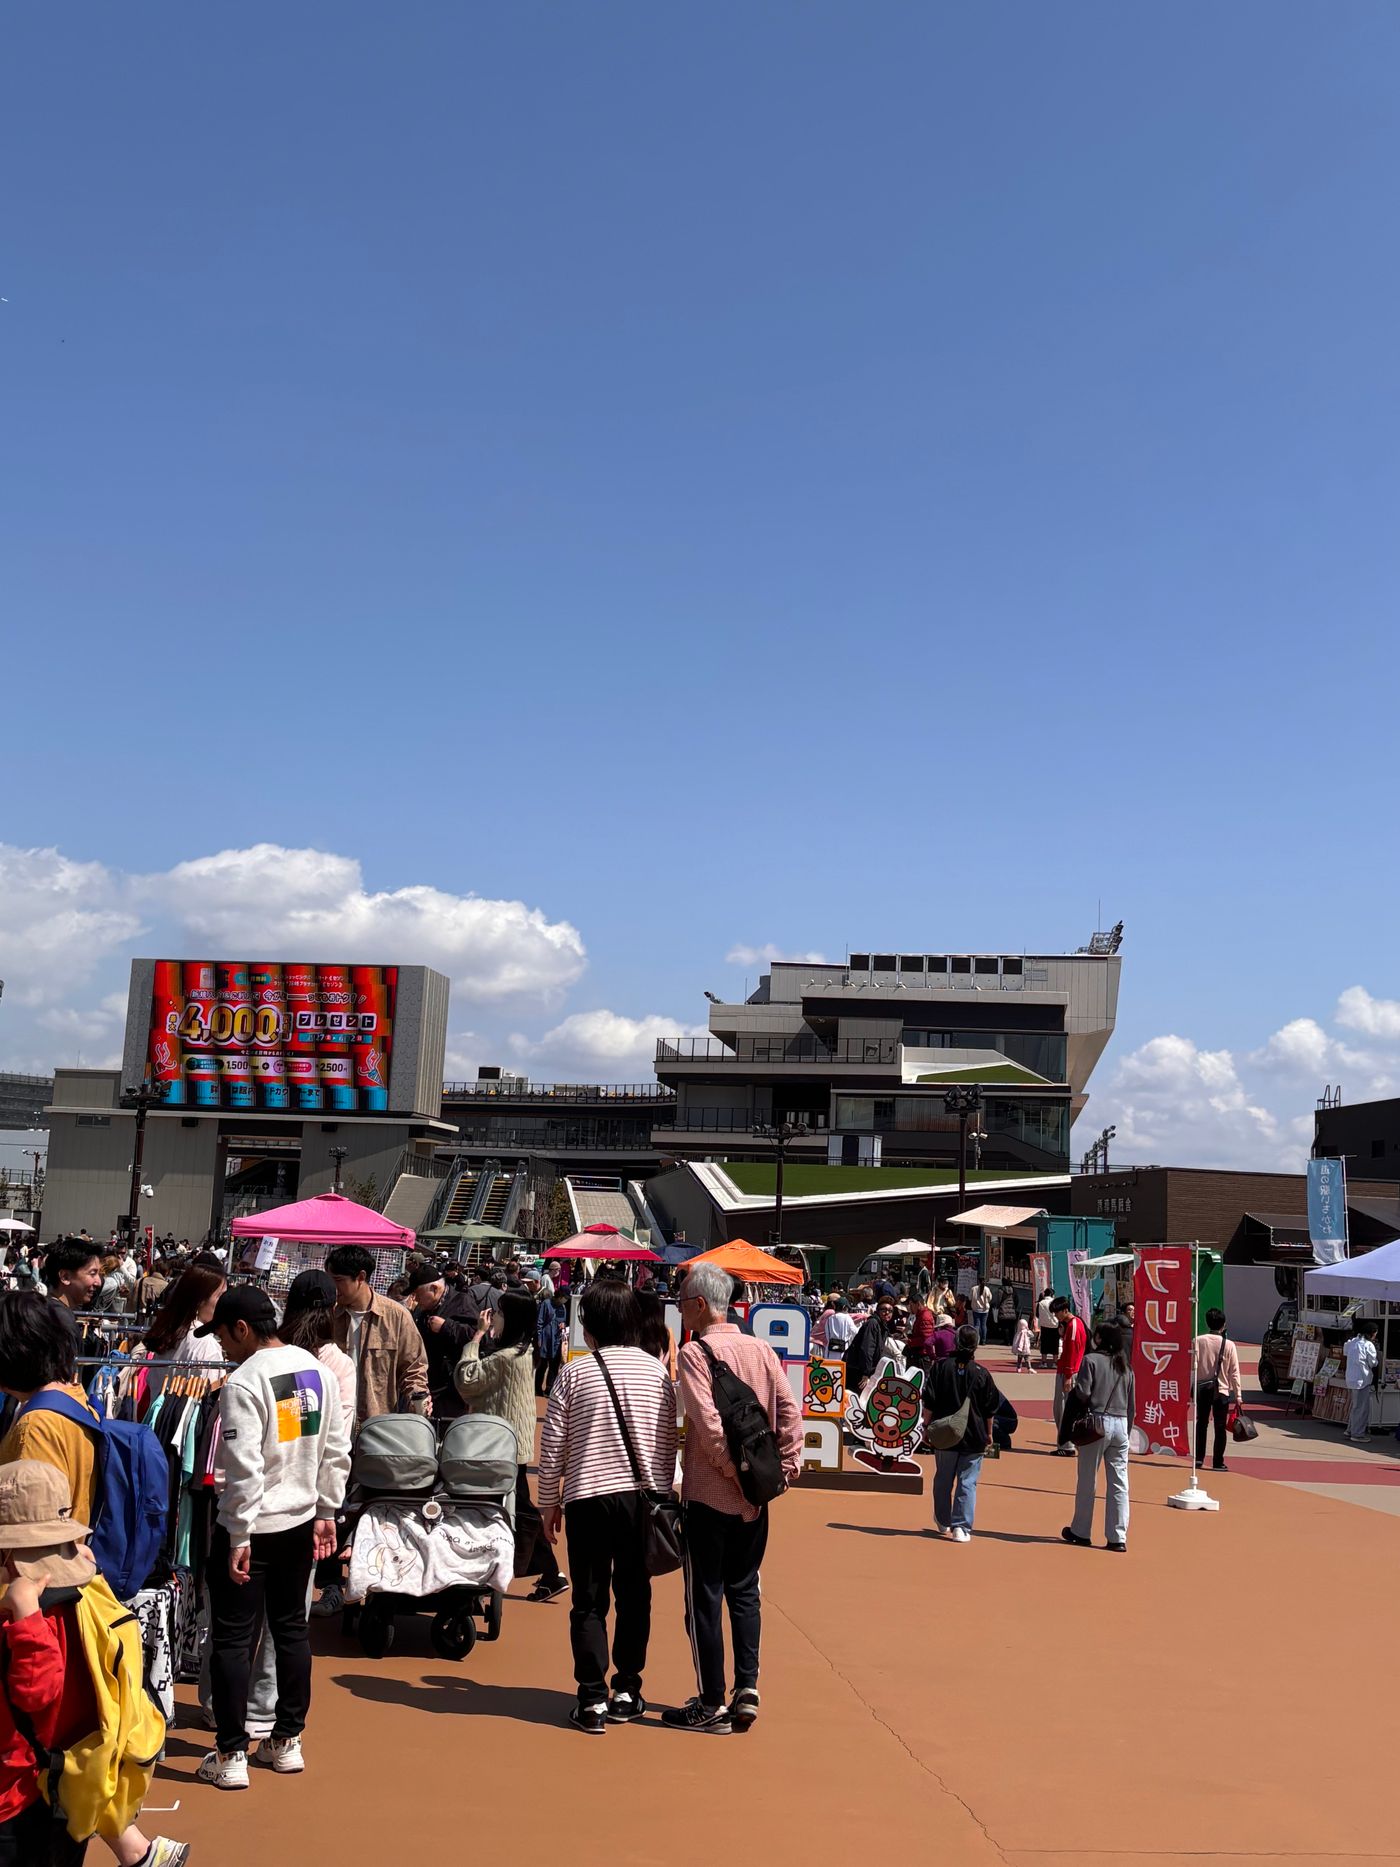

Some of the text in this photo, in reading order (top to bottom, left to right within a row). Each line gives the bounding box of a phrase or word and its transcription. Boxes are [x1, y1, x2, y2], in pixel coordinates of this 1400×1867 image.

[299, 1013, 375, 1029] プレゼント
